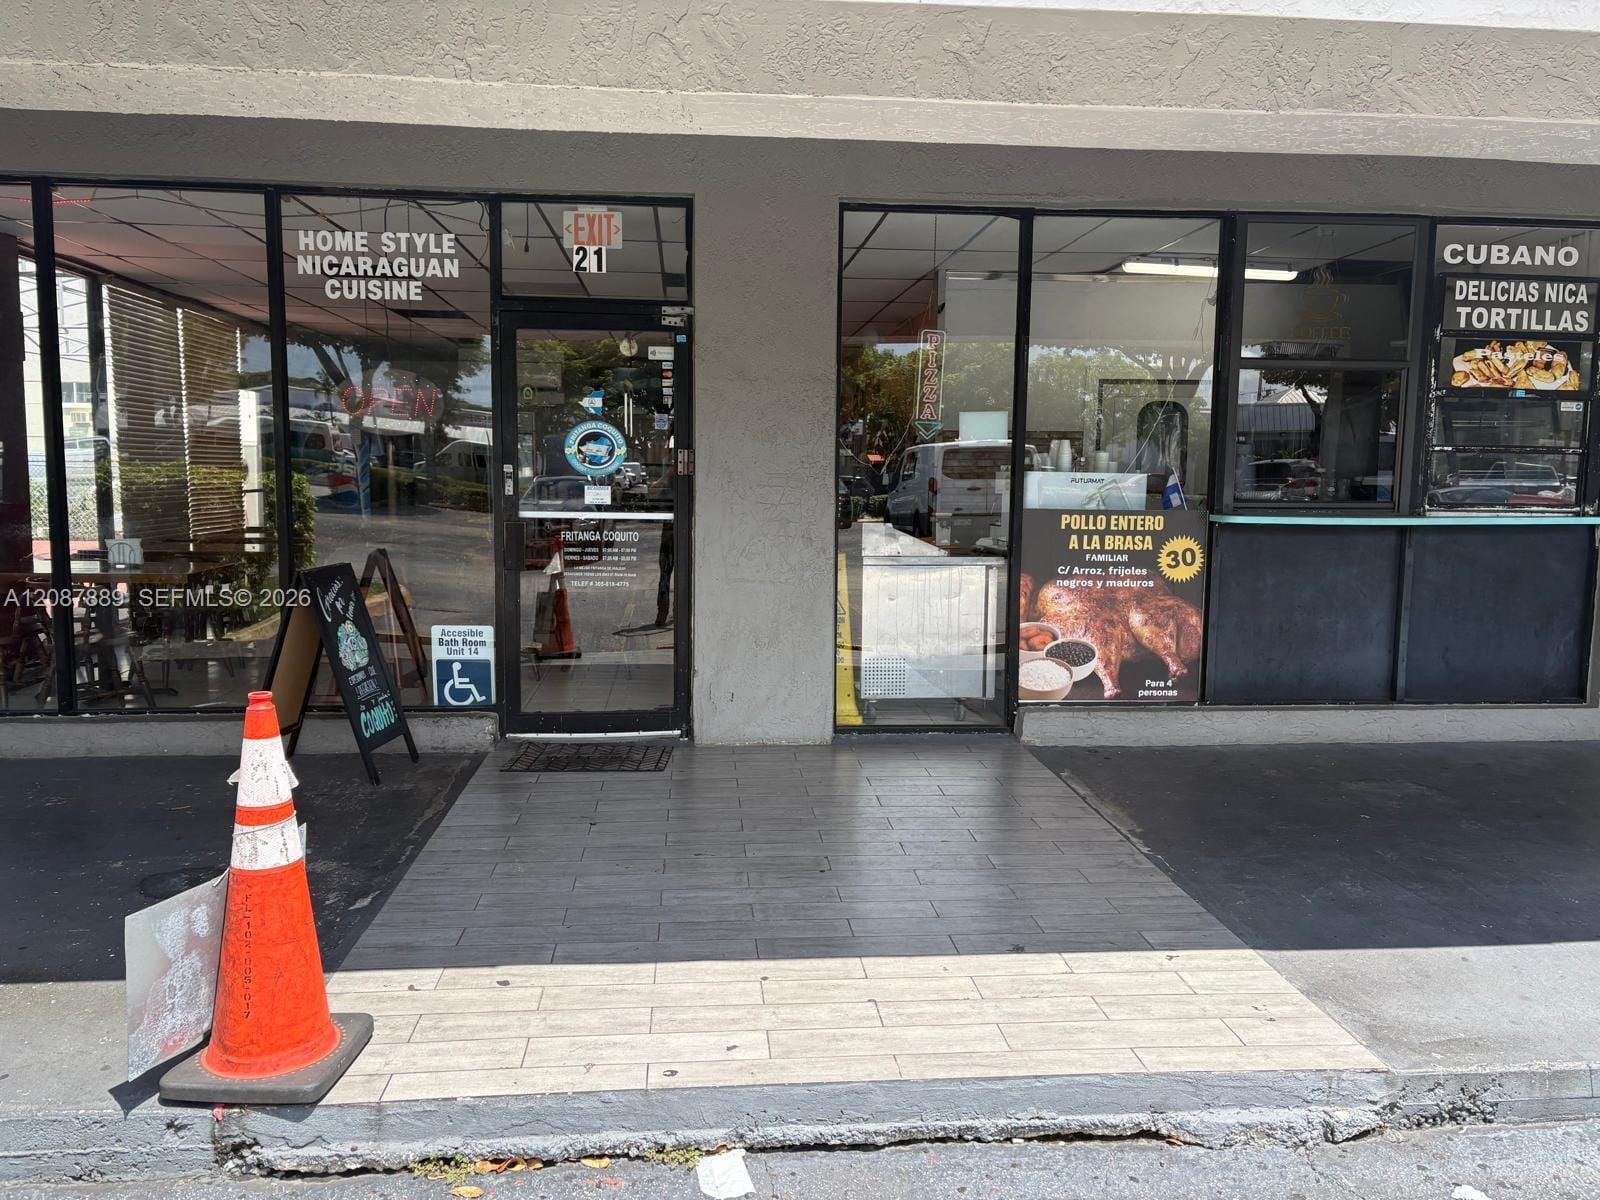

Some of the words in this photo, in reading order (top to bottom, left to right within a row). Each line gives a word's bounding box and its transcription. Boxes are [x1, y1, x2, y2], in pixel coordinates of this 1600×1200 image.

[573, 213, 615, 246] EXIT
[298, 230, 369, 252] HOME
[381, 231, 456, 254] STYLE
[574, 246, 604, 273] 21
[1443, 243, 1580, 267] CUBANO
[296, 254, 460, 278] NICARAGUAN
[324, 278, 423, 301] CUISINE
[1454, 280, 1539, 302] DELICIAS
[1545, 282, 1588, 304] NICA
[1456, 306, 1589, 332] TORTILLAS
[919, 333, 941, 420] PIZZA
[341, 385, 437, 417] OPEN
[1061, 514, 1106, 530] POLLO
[1110, 514, 1164, 531] ENTERO
[560, 531, 601, 541] FRITANGA
[602, 531, 640, 542] COQUITO
[1069, 535, 1078, 550] A
[1083, 535, 1100, 550] LA
[1104, 535, 1153, 551] BRASA
[1085, 553, 1129, 562] FAMILIAR
[1165, 547, 1197, 569] 30
[1057, 565, 1070, 575] C/
[1072, 566, 1105, 576] Arroz,
[1108, 565, 1148, 578] frijoles
[1056, 579, 1093, 589] negros
[1096, 579, 1103, 589] y
[1106, 578, 1154, 588] maduros
[438, 637, 459, 647] Bath
[462, 638, 487, 647] Room
[440, 628, 484, 638] Accesible
[446, 647, 465, 656] Unit
[468, 647, 479, 656] 14
[1138, 688, 1178, 698] personas
[1145, 679, 1165, 688] Para
[1166, 679, 1173, 688] 4
